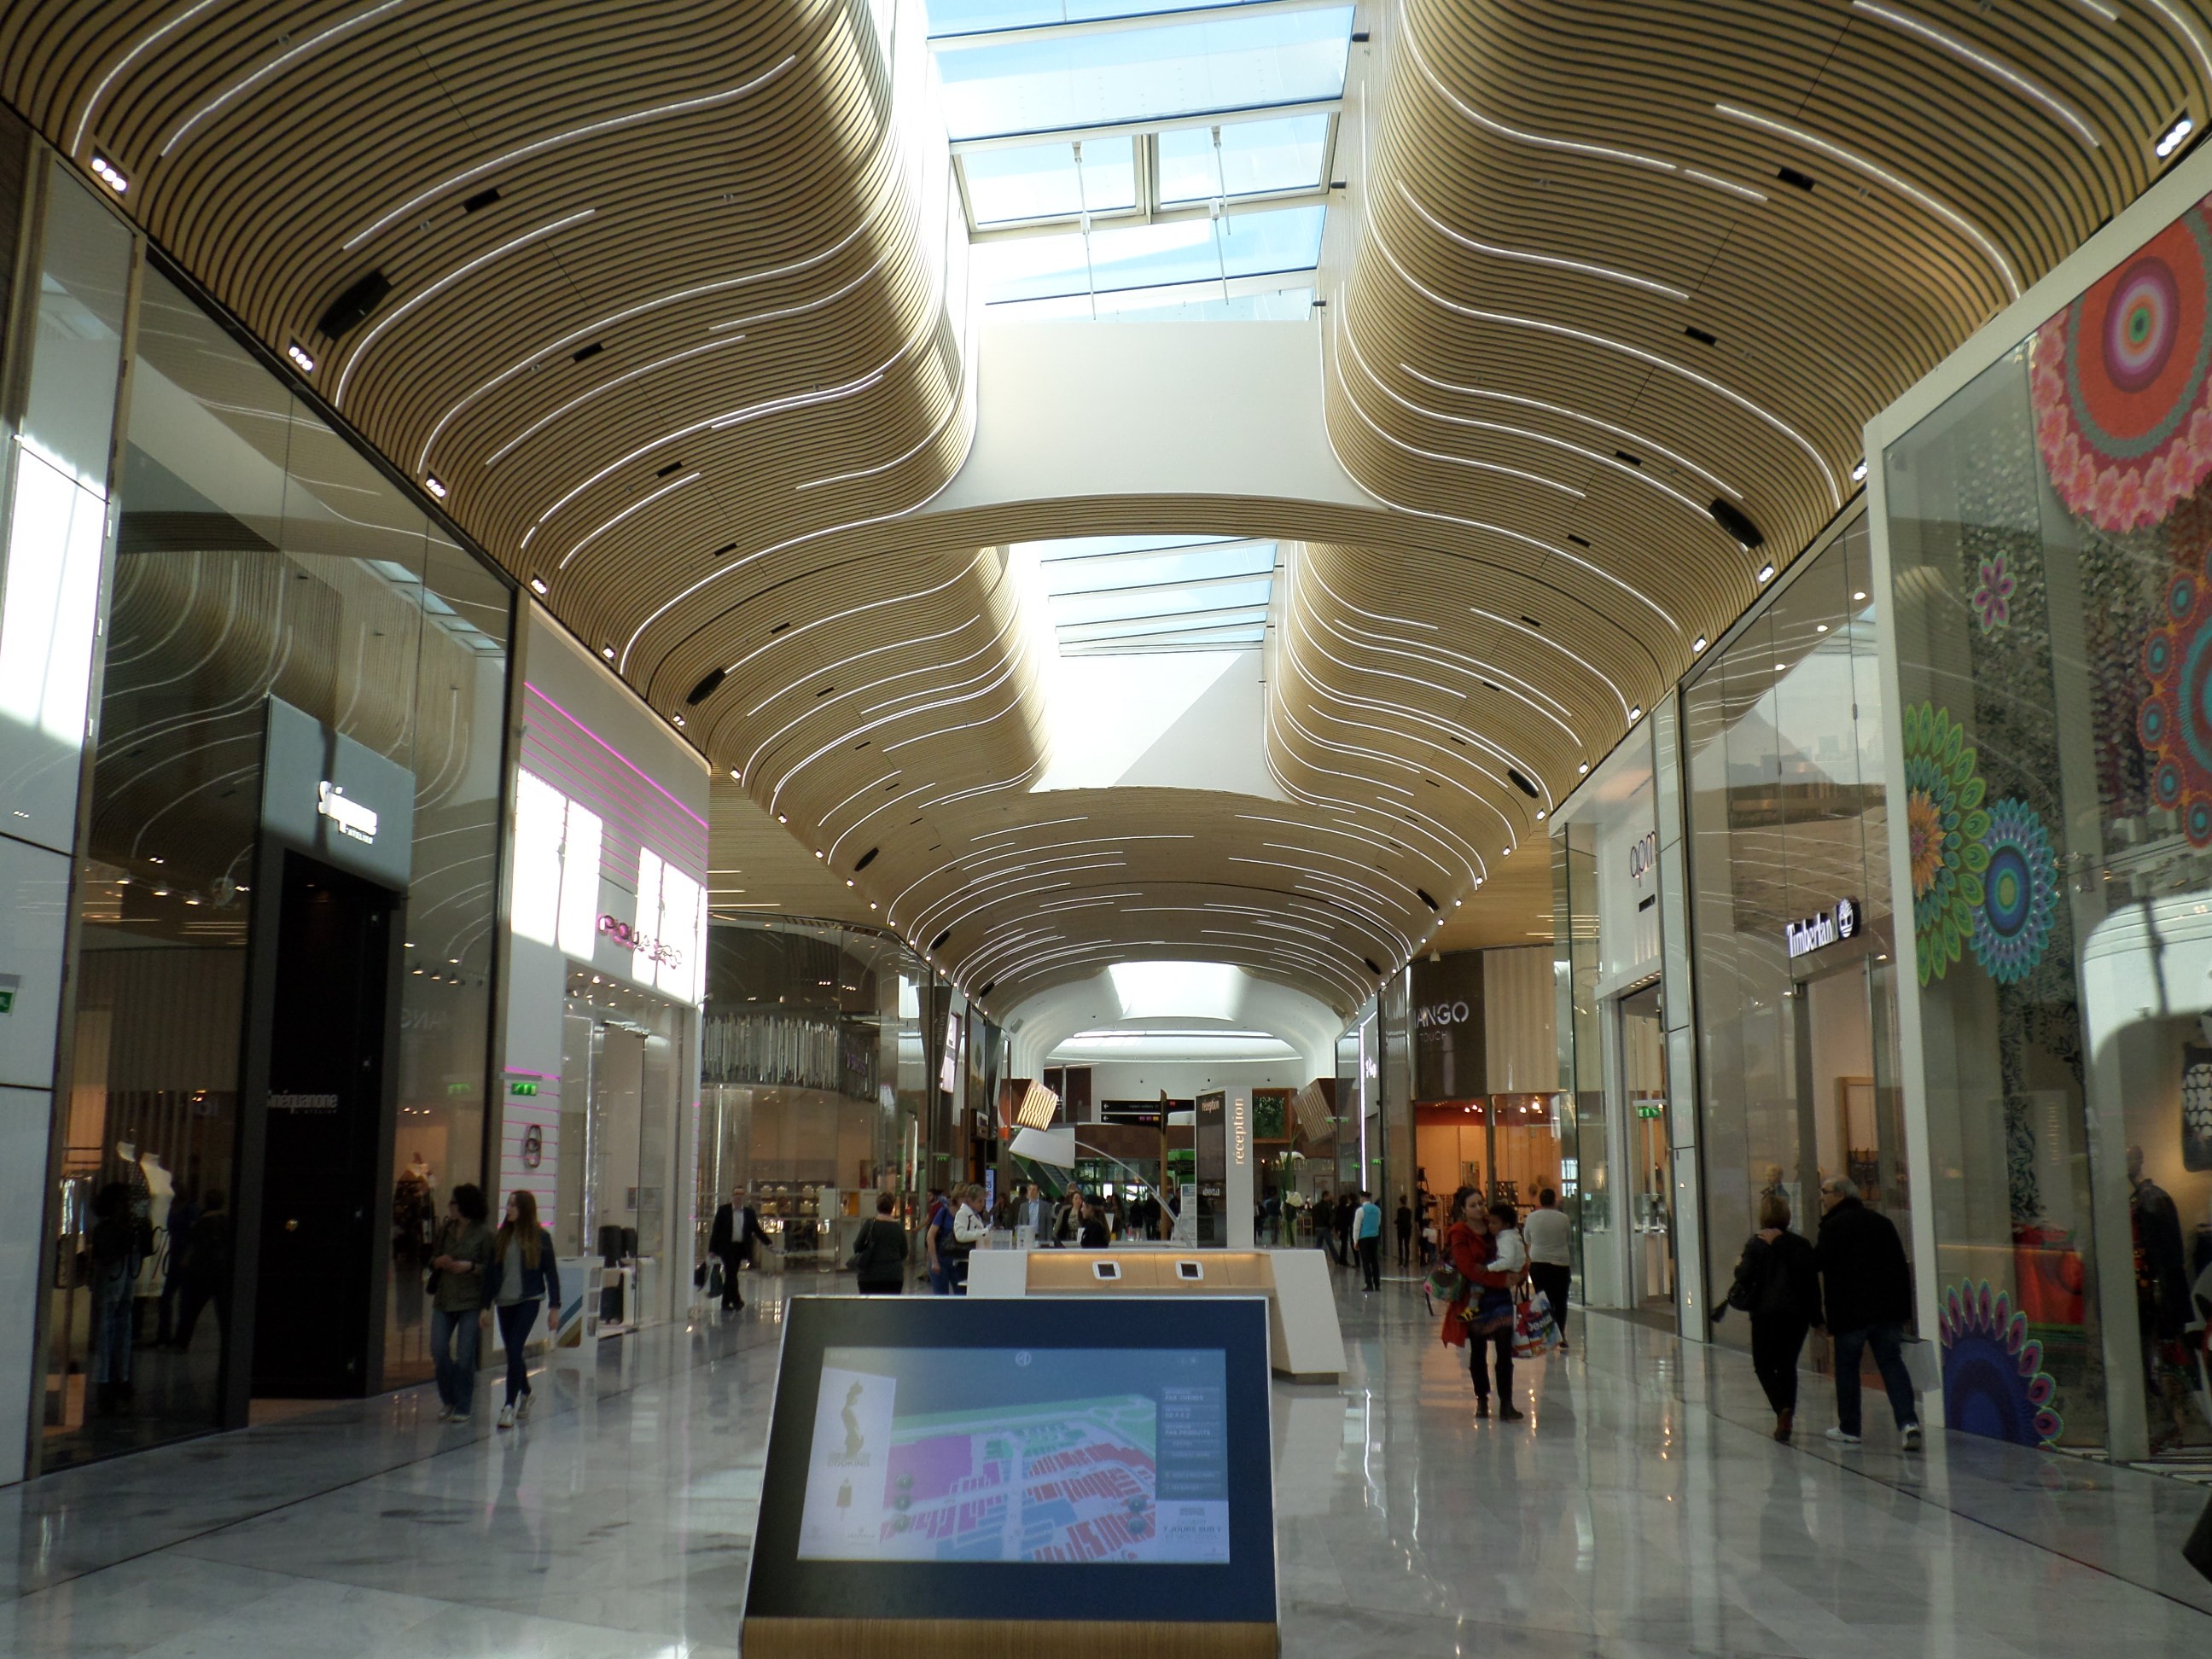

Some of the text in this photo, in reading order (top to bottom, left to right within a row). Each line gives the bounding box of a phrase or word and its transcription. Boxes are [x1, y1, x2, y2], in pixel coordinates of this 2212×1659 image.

[1786, 905, 1839, 958] Timberland
[1414, 1001, 1470, 1028] ANGO
[1419, 1030, 1448, 1042] TOUCH
[266, 1089, 338, 1115] inéquanone
[1231, 1098, 1247, 1165] réception
